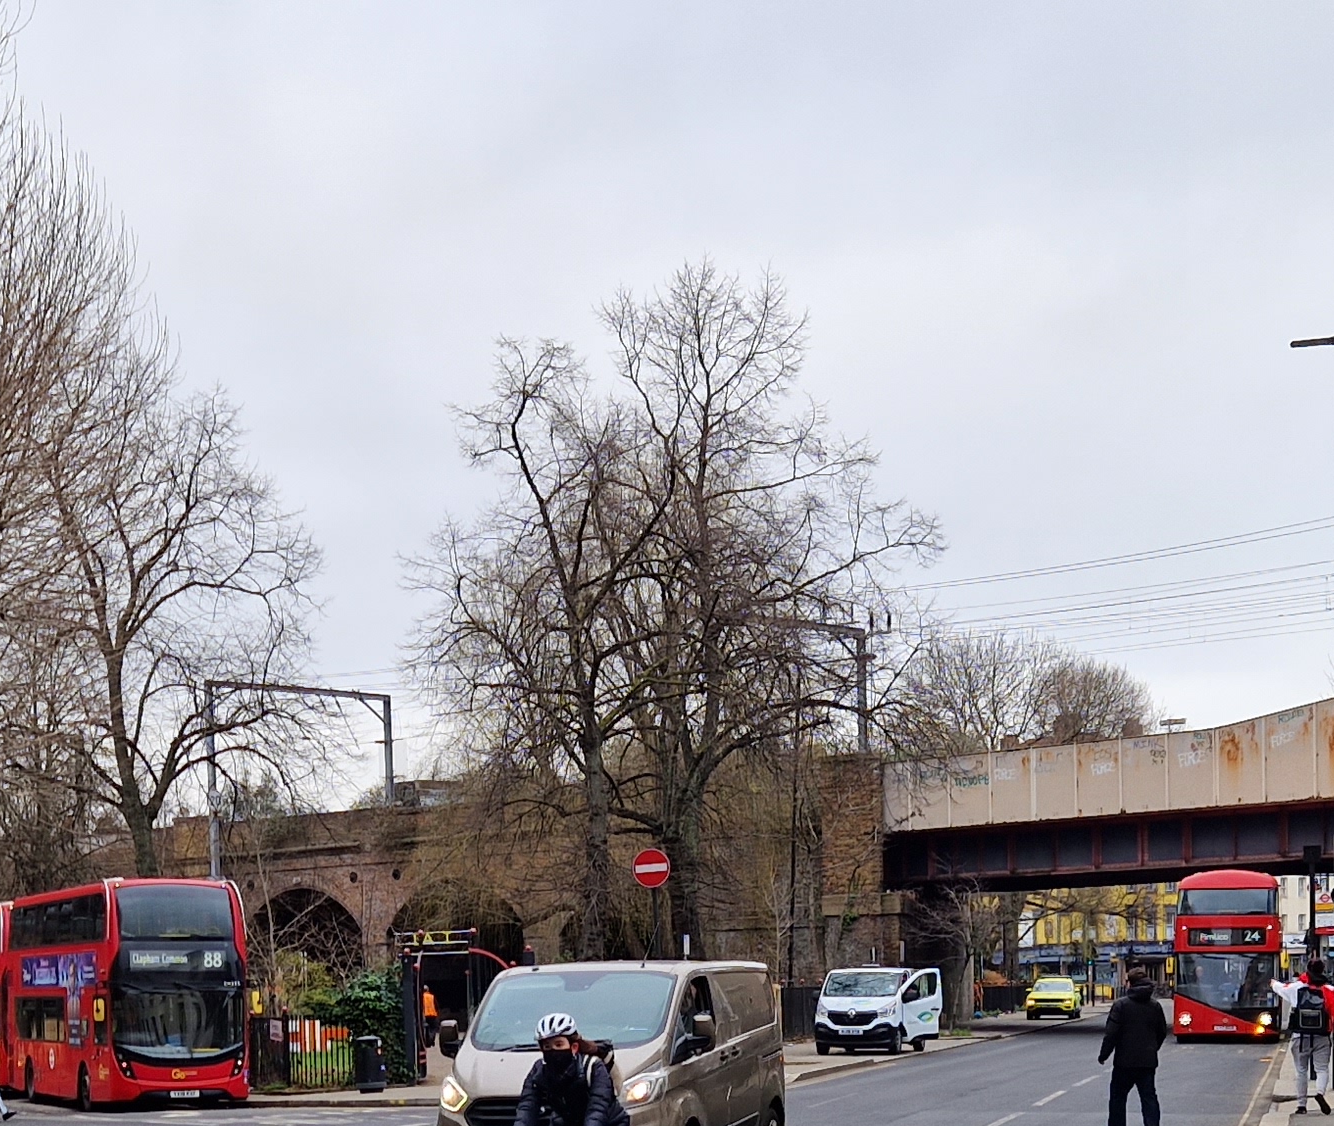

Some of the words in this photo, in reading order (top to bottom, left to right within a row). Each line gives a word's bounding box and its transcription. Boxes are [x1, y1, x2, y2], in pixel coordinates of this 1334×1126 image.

[1200, 932, 1229, 942] Pimlico
[1244, 930, 1261, 942] 24
[133, 953, 160, 966] Clapham
[162, 953, 188, 964] Common
[203, 952, 223, 968] 88
